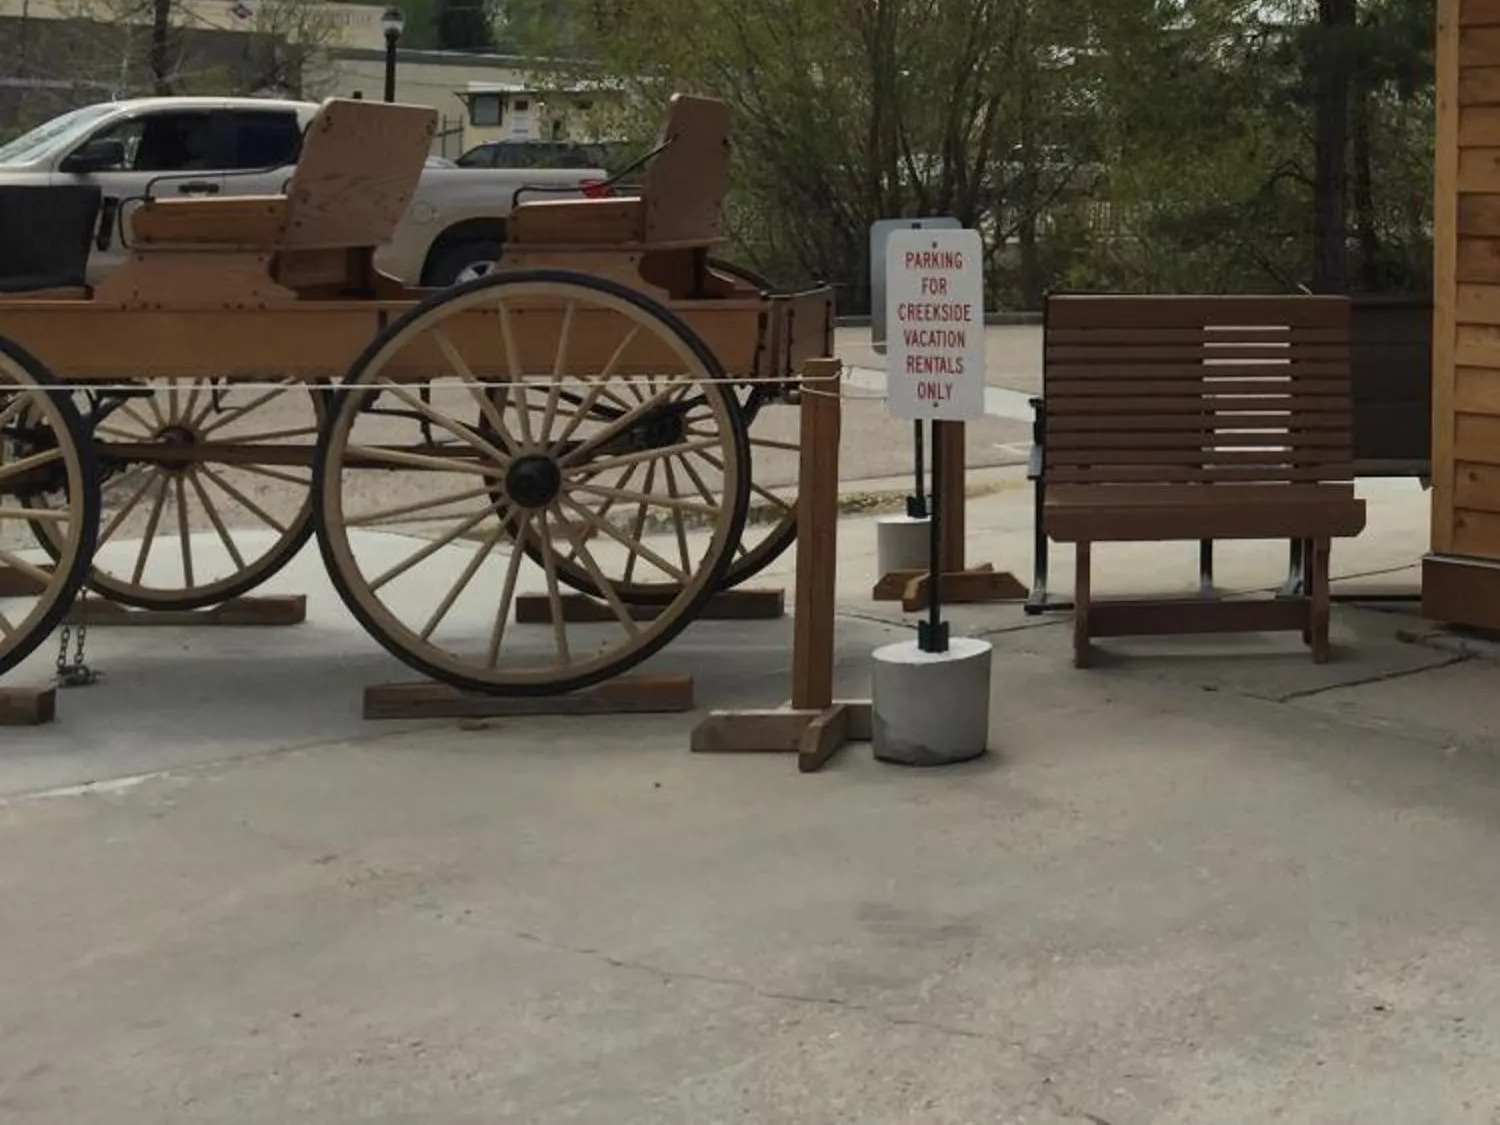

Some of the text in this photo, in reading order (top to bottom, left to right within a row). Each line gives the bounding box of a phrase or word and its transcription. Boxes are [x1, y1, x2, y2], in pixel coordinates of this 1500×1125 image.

[905, 252, 963, 269] PARKING
[921, 277, 947, 295] FOR
[897, 303, 972, 321] CREEKSIDE
[903, 330, 965, 348] VACATION
[906, 355, 964, 374] RENTALS
[917, 382, 953, 400] ONLY
